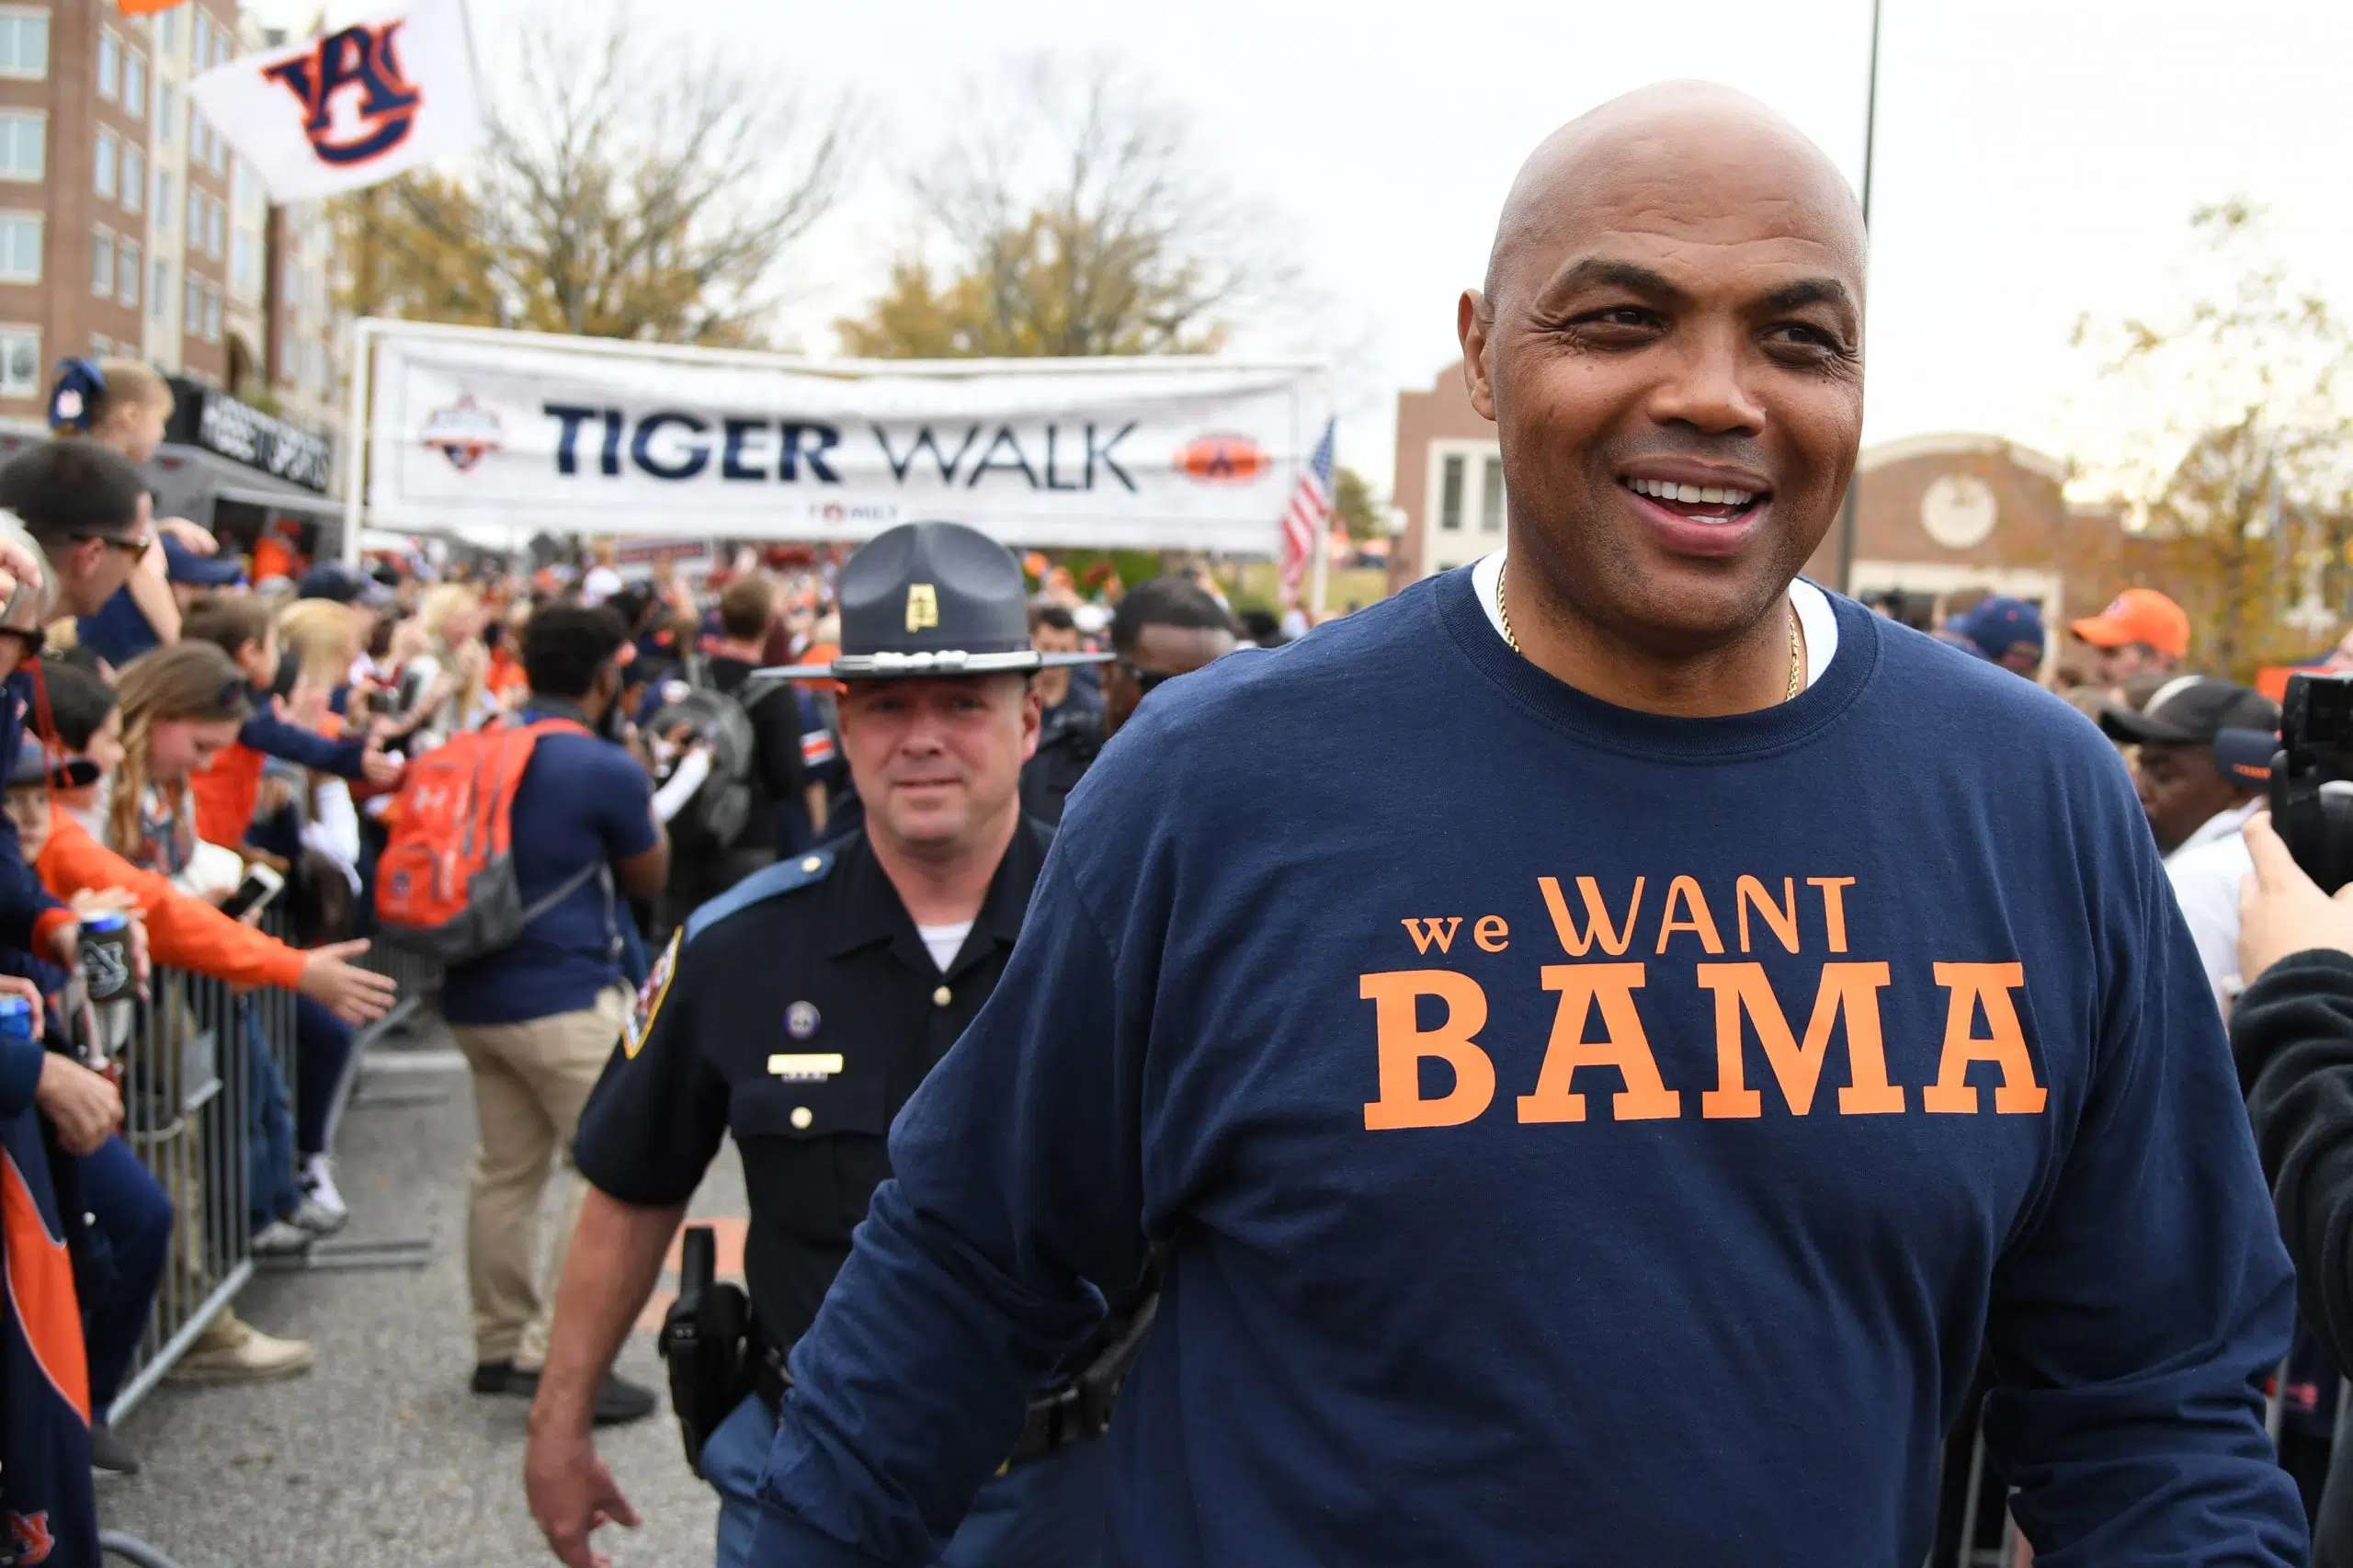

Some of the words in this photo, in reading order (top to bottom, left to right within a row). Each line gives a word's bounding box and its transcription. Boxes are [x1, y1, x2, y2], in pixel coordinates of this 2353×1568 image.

[542, 402, 841, 485] TIGER
[869, 419, 1141, 494] WALK
[1401, 915, 1510, 954] we
[1538, 874, 1857, 957] WANT
[1359, 960, 2049, 1131] BAMA
